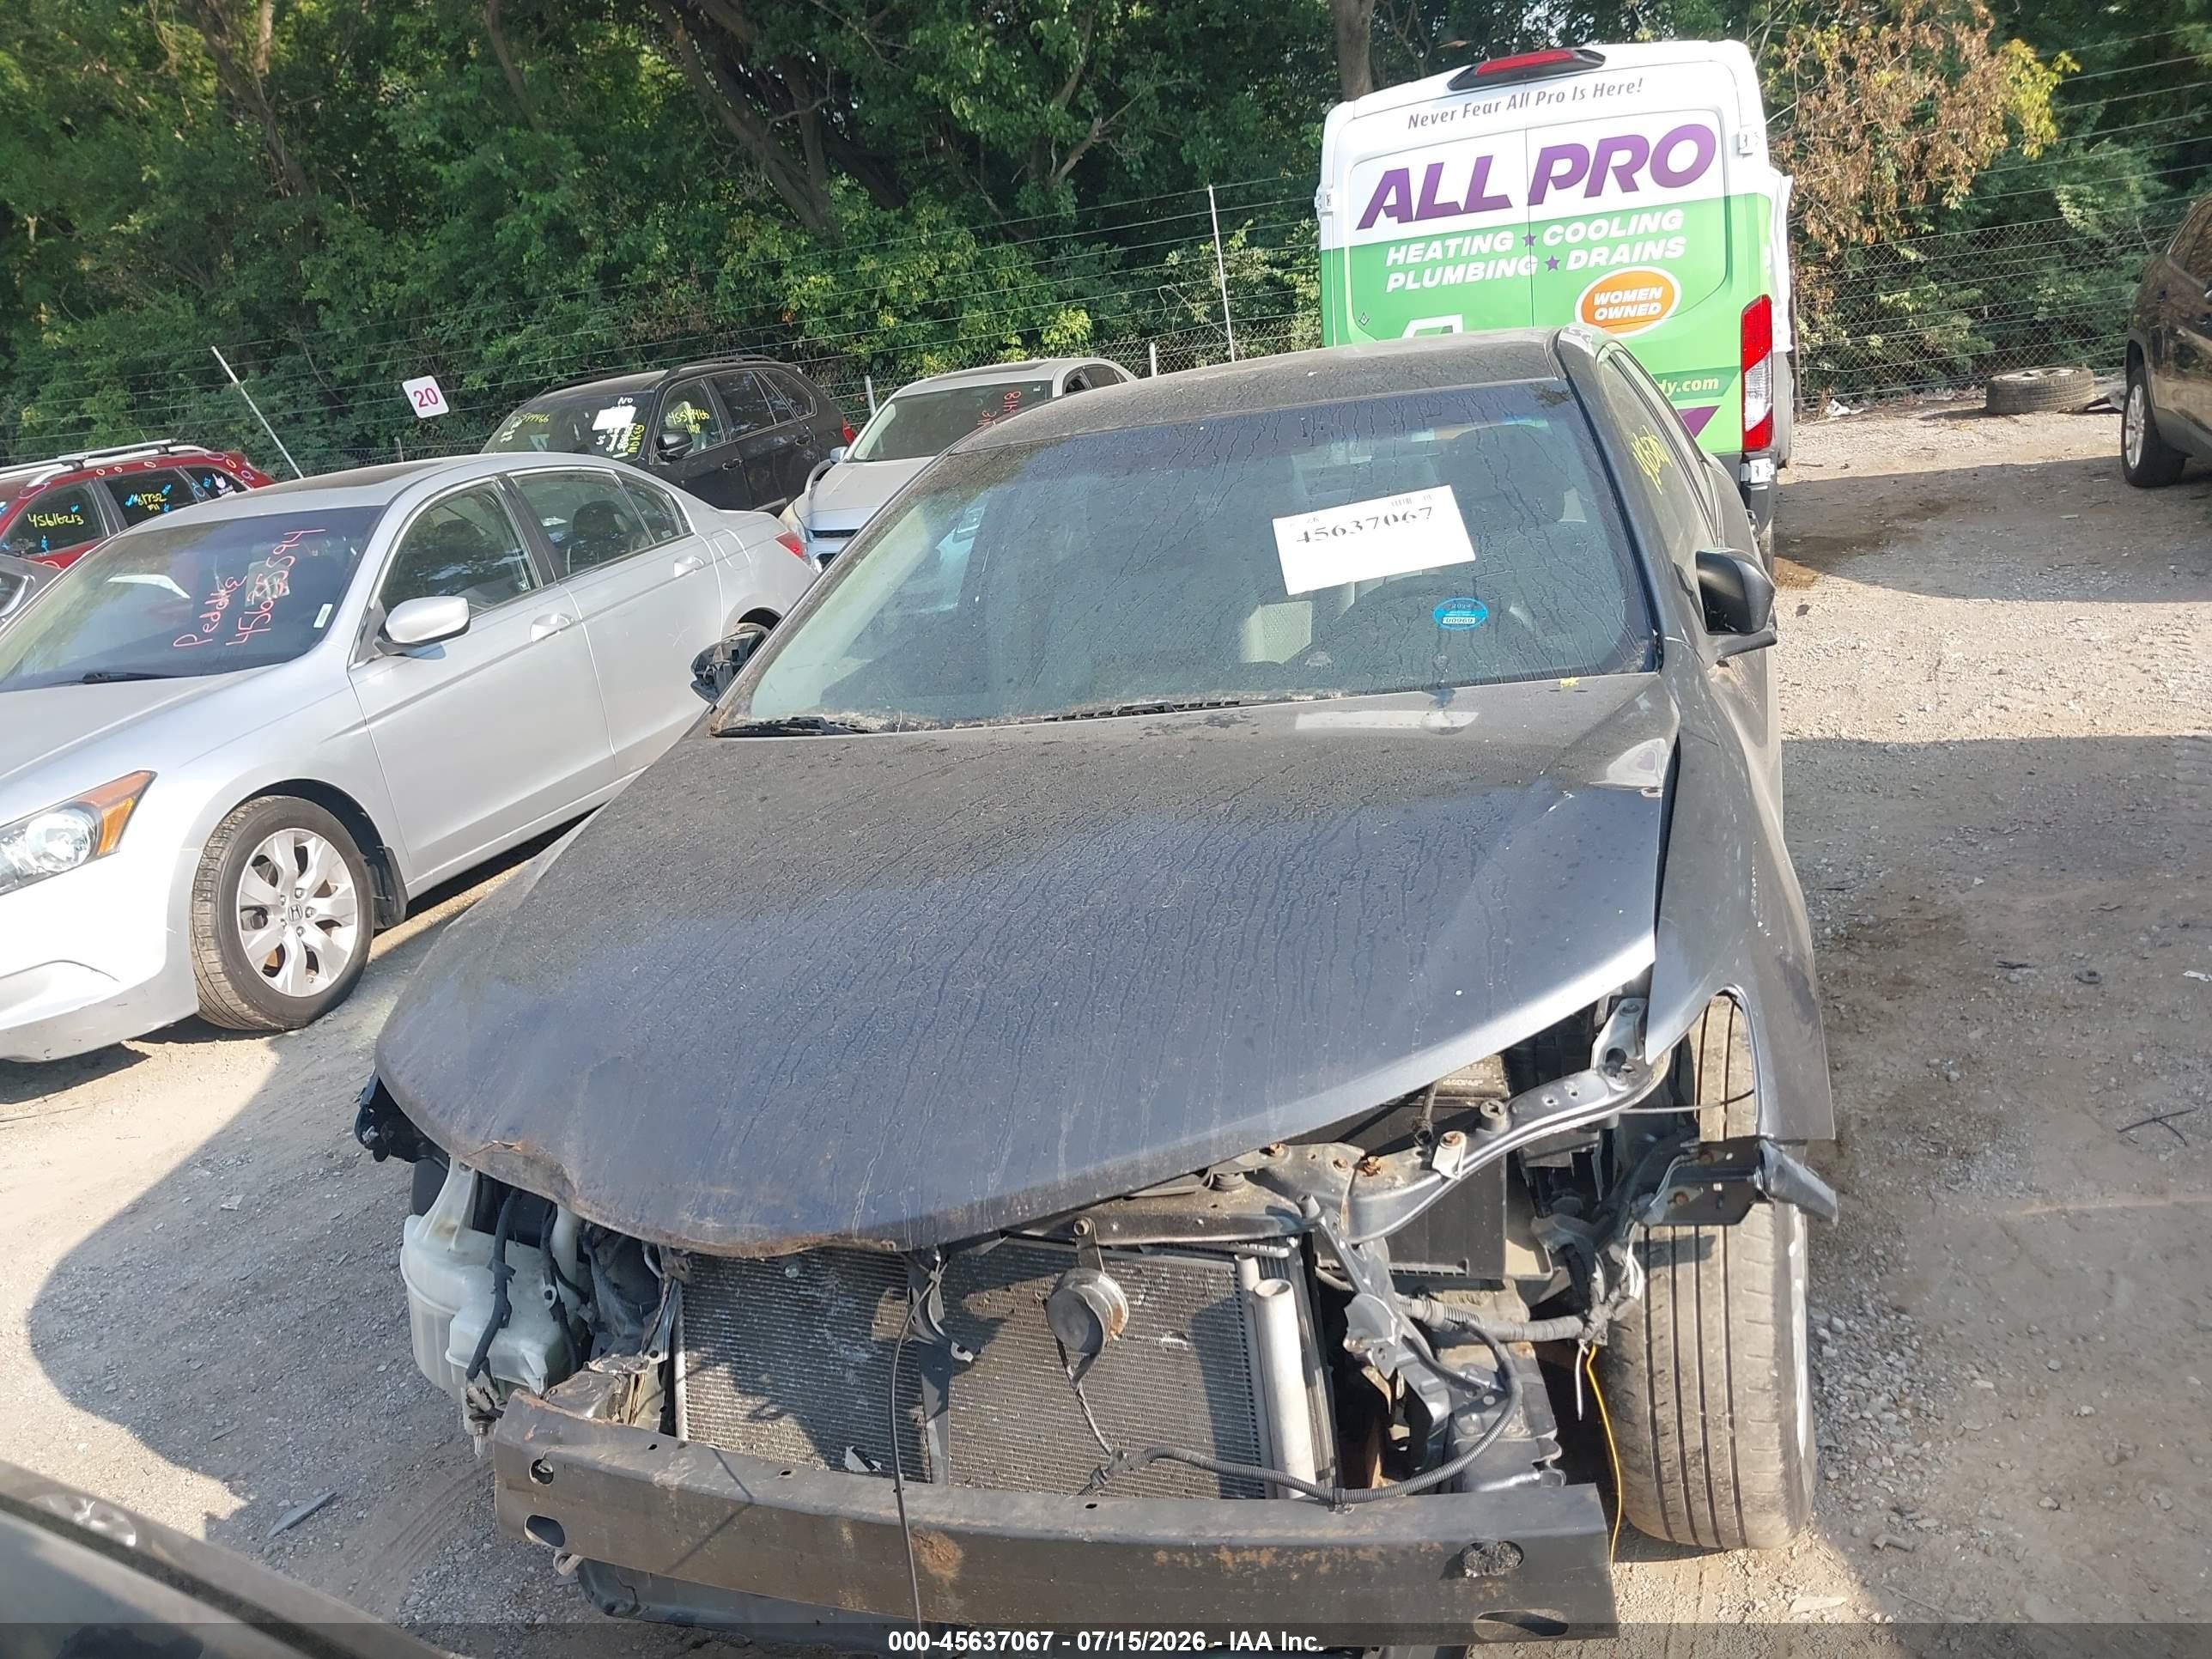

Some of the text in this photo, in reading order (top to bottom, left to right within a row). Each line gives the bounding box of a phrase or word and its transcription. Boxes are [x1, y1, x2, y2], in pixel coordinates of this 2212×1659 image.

[1407, 77, 1644, 130] Never Fear All Pro Is Here!
[1355, 123, 1717, 230] ALL PRO
[1385, 208, 1685, 268] HEATING COOLING
[1384, 235, 1686, 294] PLUMBING DRAINS
[1593, 286, 1663, 307] WOMEN
[1593, 302, 1662, 322] OWNED
[413, 387, 439, 409] 20
[27, 513, 85, 529] 45616213
[1296, 506, 1433, 544] 45637067
